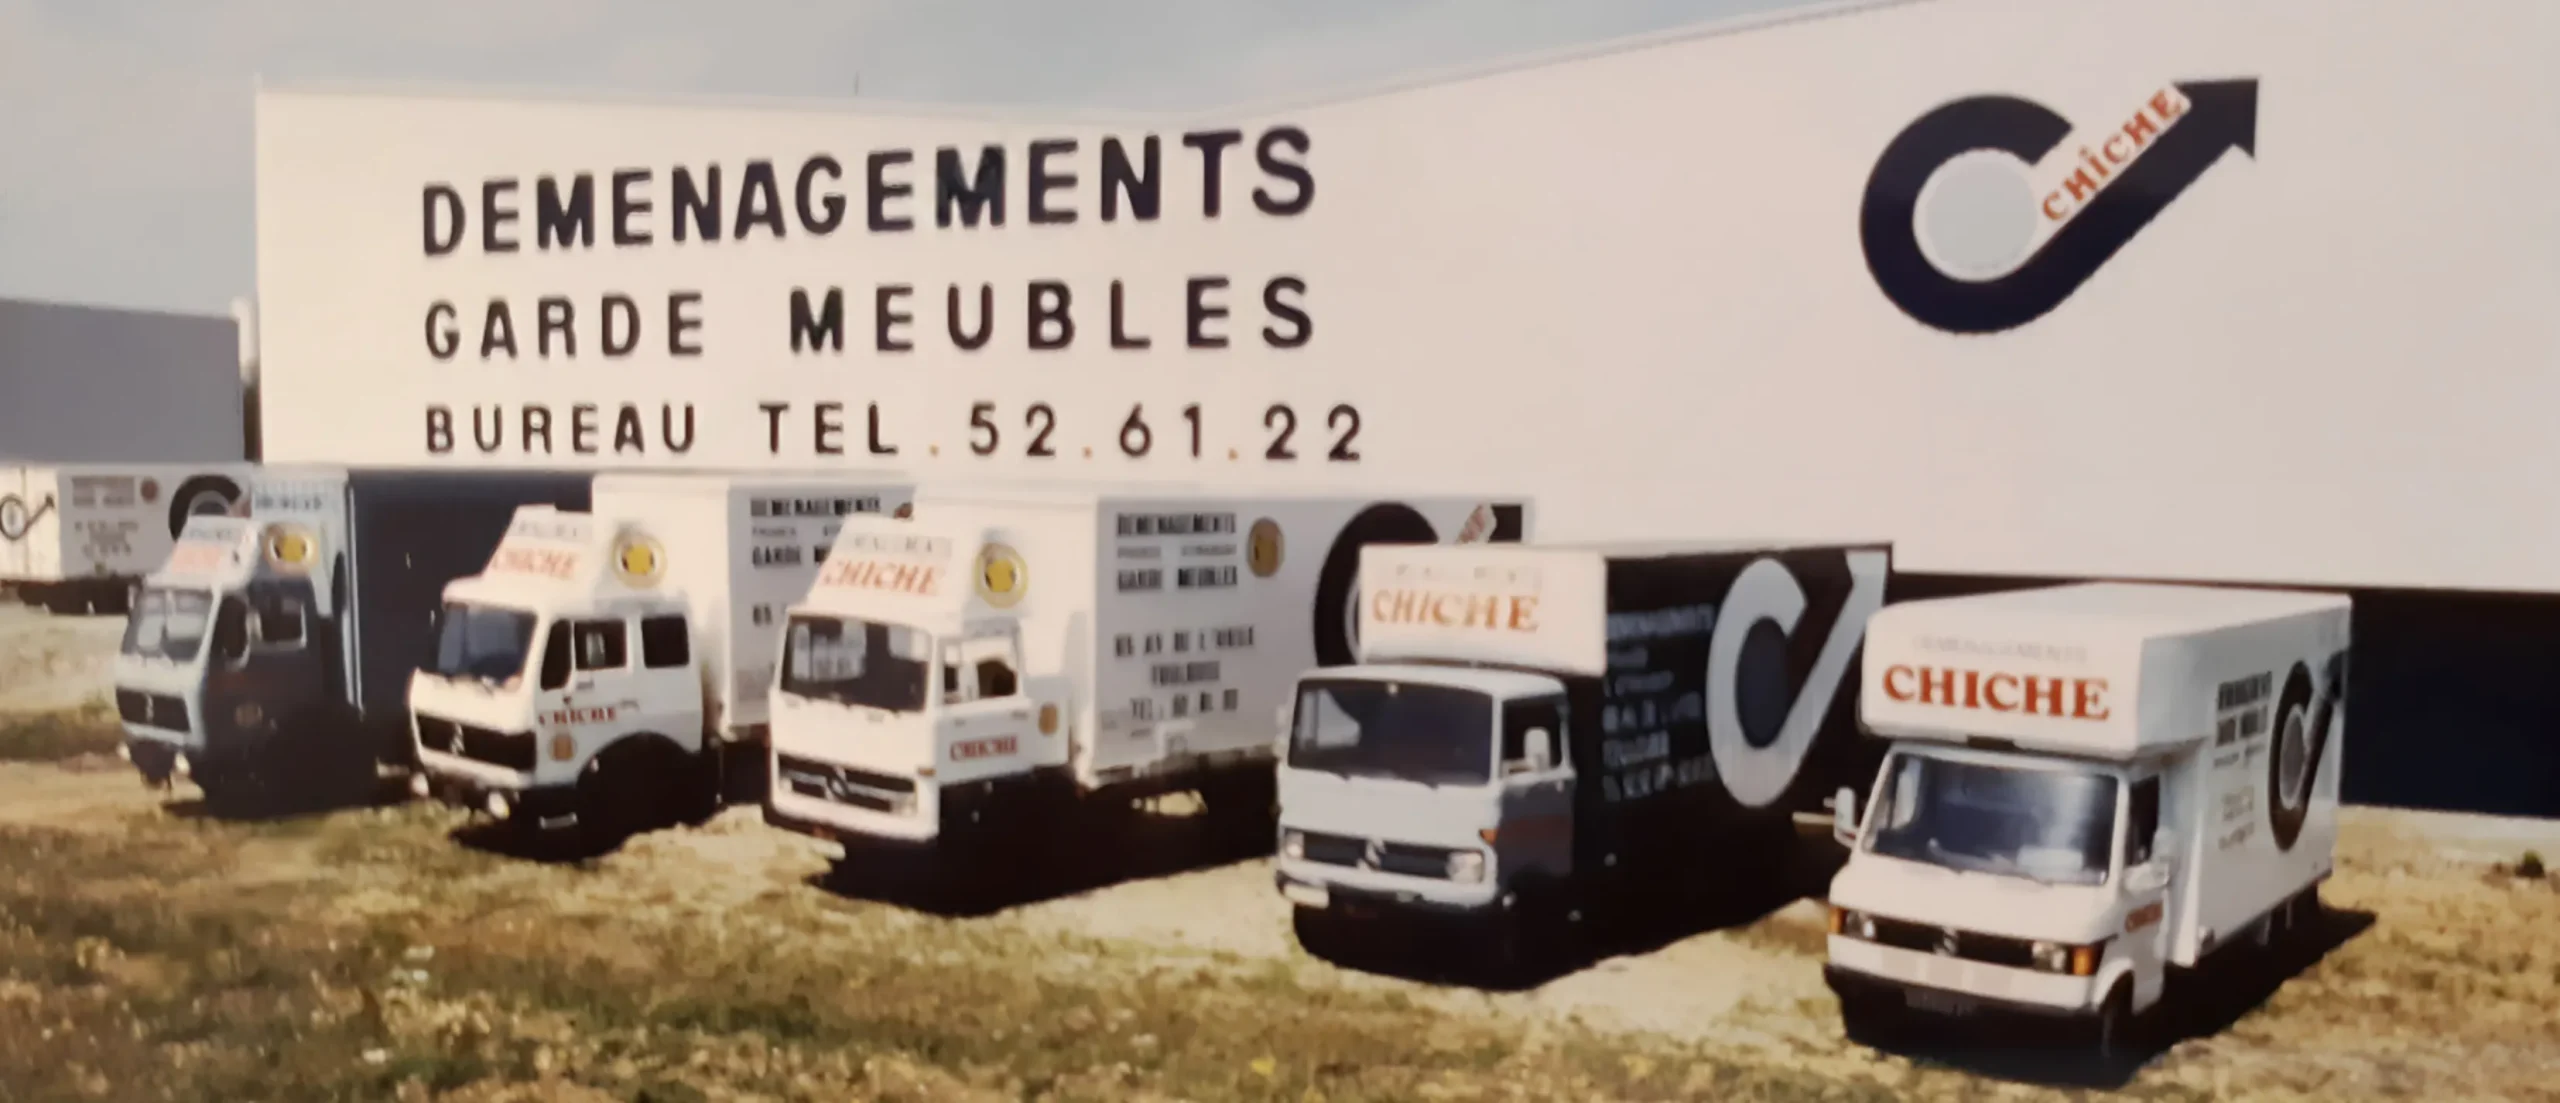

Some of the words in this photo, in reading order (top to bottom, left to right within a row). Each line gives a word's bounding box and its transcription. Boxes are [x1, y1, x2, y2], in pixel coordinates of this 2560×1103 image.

[422, 125, 1317, 257] DEMENAGEMENTS
[424, 292, 704, 360] GARDE
[788, 275, 1315, 354] MEUBLES
[425, 402, 697, 456] BUREAU
[1372, 588, 1541, 634] CHICHE
[1882, 663, 2111, 722] CHICHE
